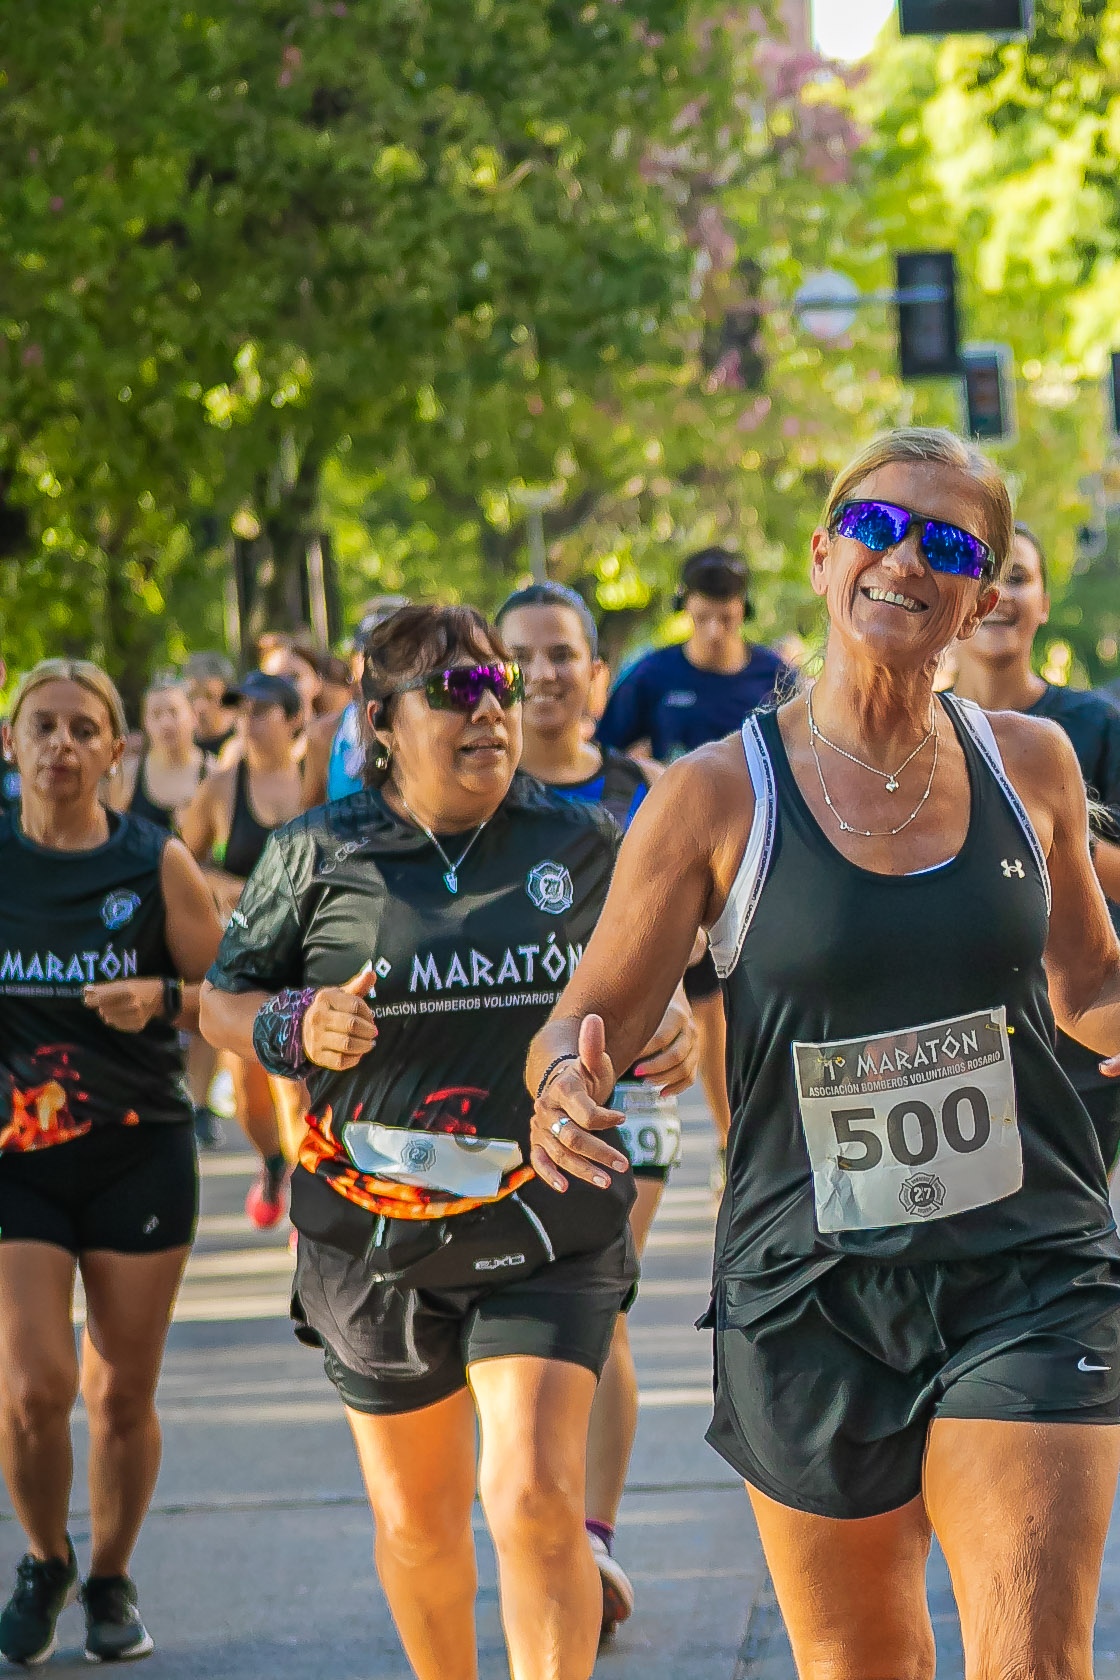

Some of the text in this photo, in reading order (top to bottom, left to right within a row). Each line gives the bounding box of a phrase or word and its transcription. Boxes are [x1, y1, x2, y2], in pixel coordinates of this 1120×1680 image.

[0, 942, 138, 982] MARATÓN
[409, 932, 583, 992] MARATÓN
[419, 996, 481, 1013] BOMBEROS
[483, 991, 555, 1009] VOLUNTARIOS
[809, 1051, 1001, 1098] ASOCIACIÓN BOMBEROS VOLUNTARIOS ROSARIO
[856, 1027, 979, 1078] MARATÓN
[831, 1086, 991, 1172] 500
[913, 1187, 932, 1203] 27
